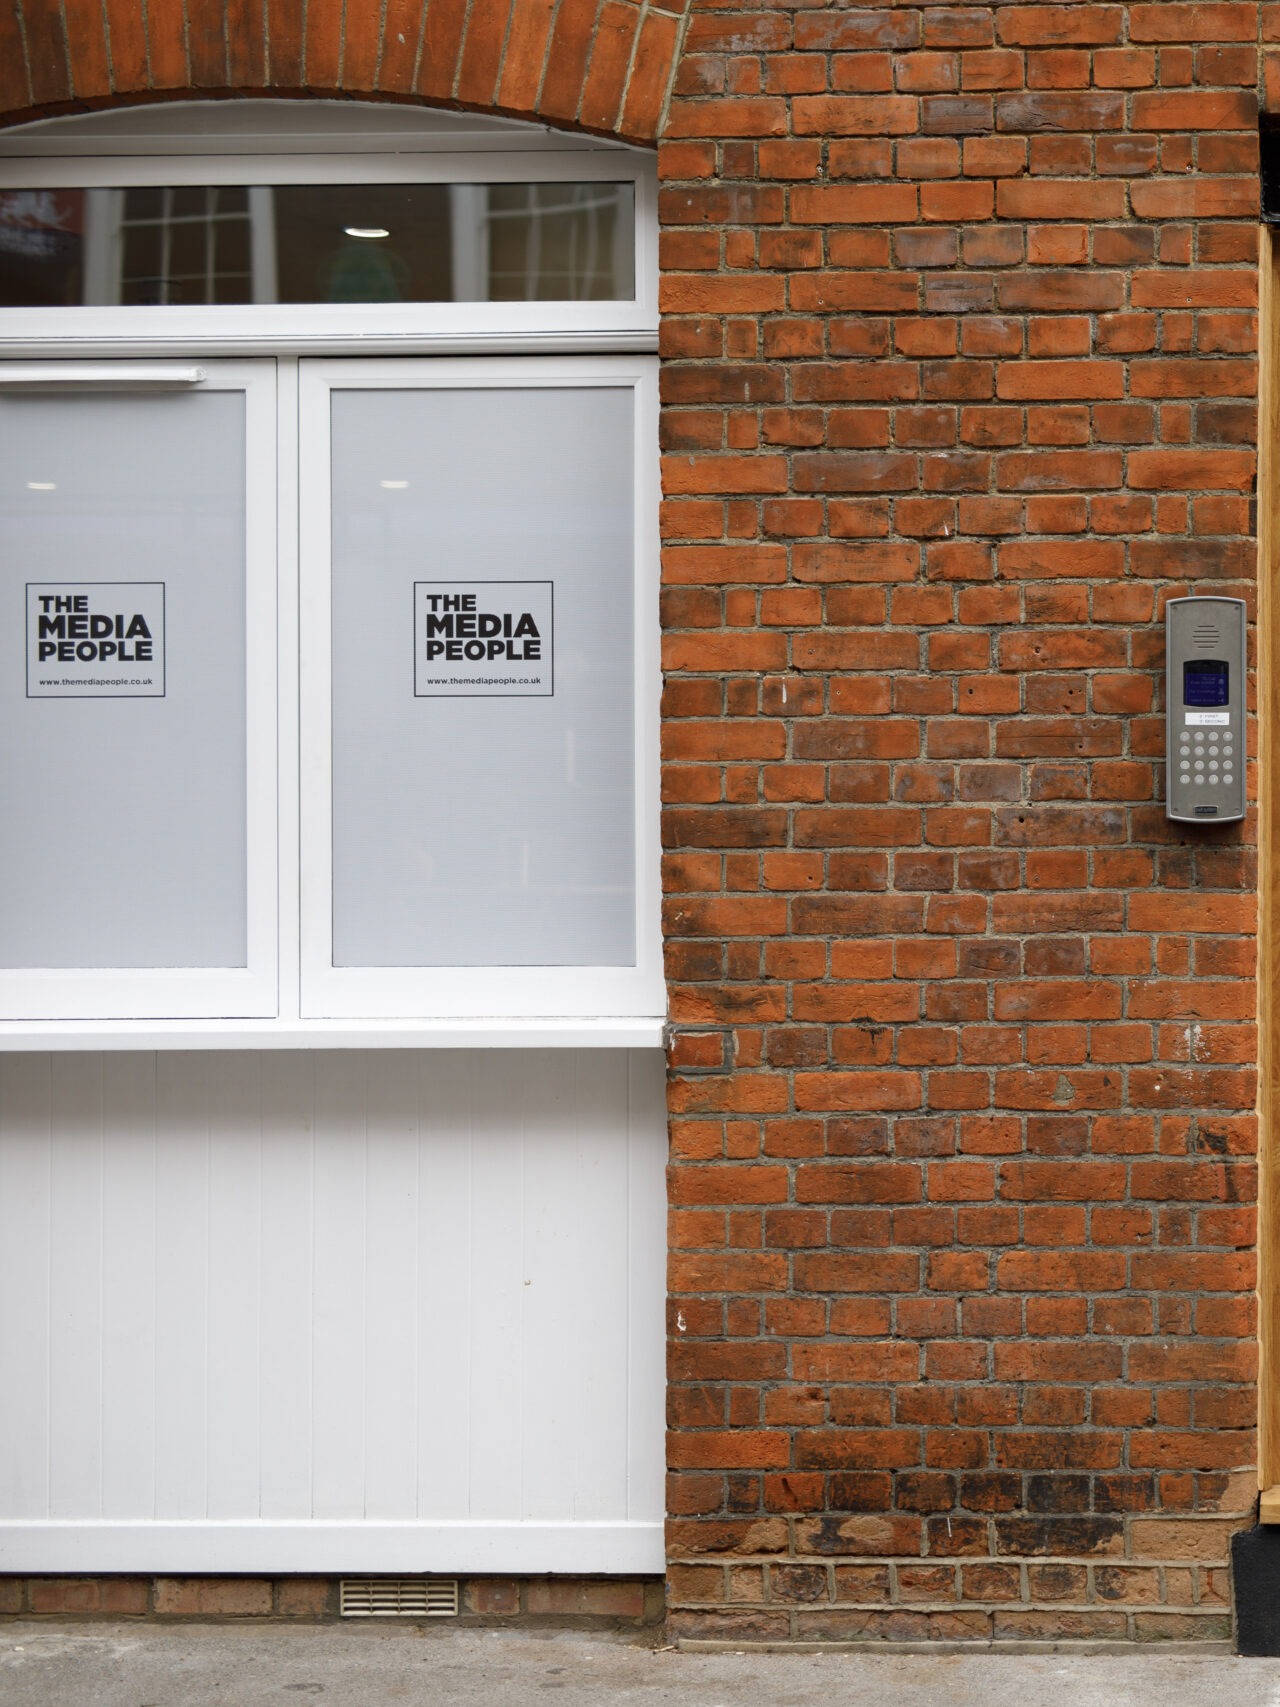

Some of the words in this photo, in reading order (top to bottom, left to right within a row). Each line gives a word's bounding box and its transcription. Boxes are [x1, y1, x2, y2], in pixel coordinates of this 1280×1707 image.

[38, 595, 88, 613] THE
[426, 594, 477, 612] THE
[38, 614, 152, 639] MEDIA
[426, 613, 541, 638] MEDIA
[38, 641, 153, 662] PEOPLE
[426, 640, 541, 661] PEOPLE
[39, 678, 153, 687] www.themediapeople.co.uk
[427, 677, 541, 686] www.themediapeople.co.uk
